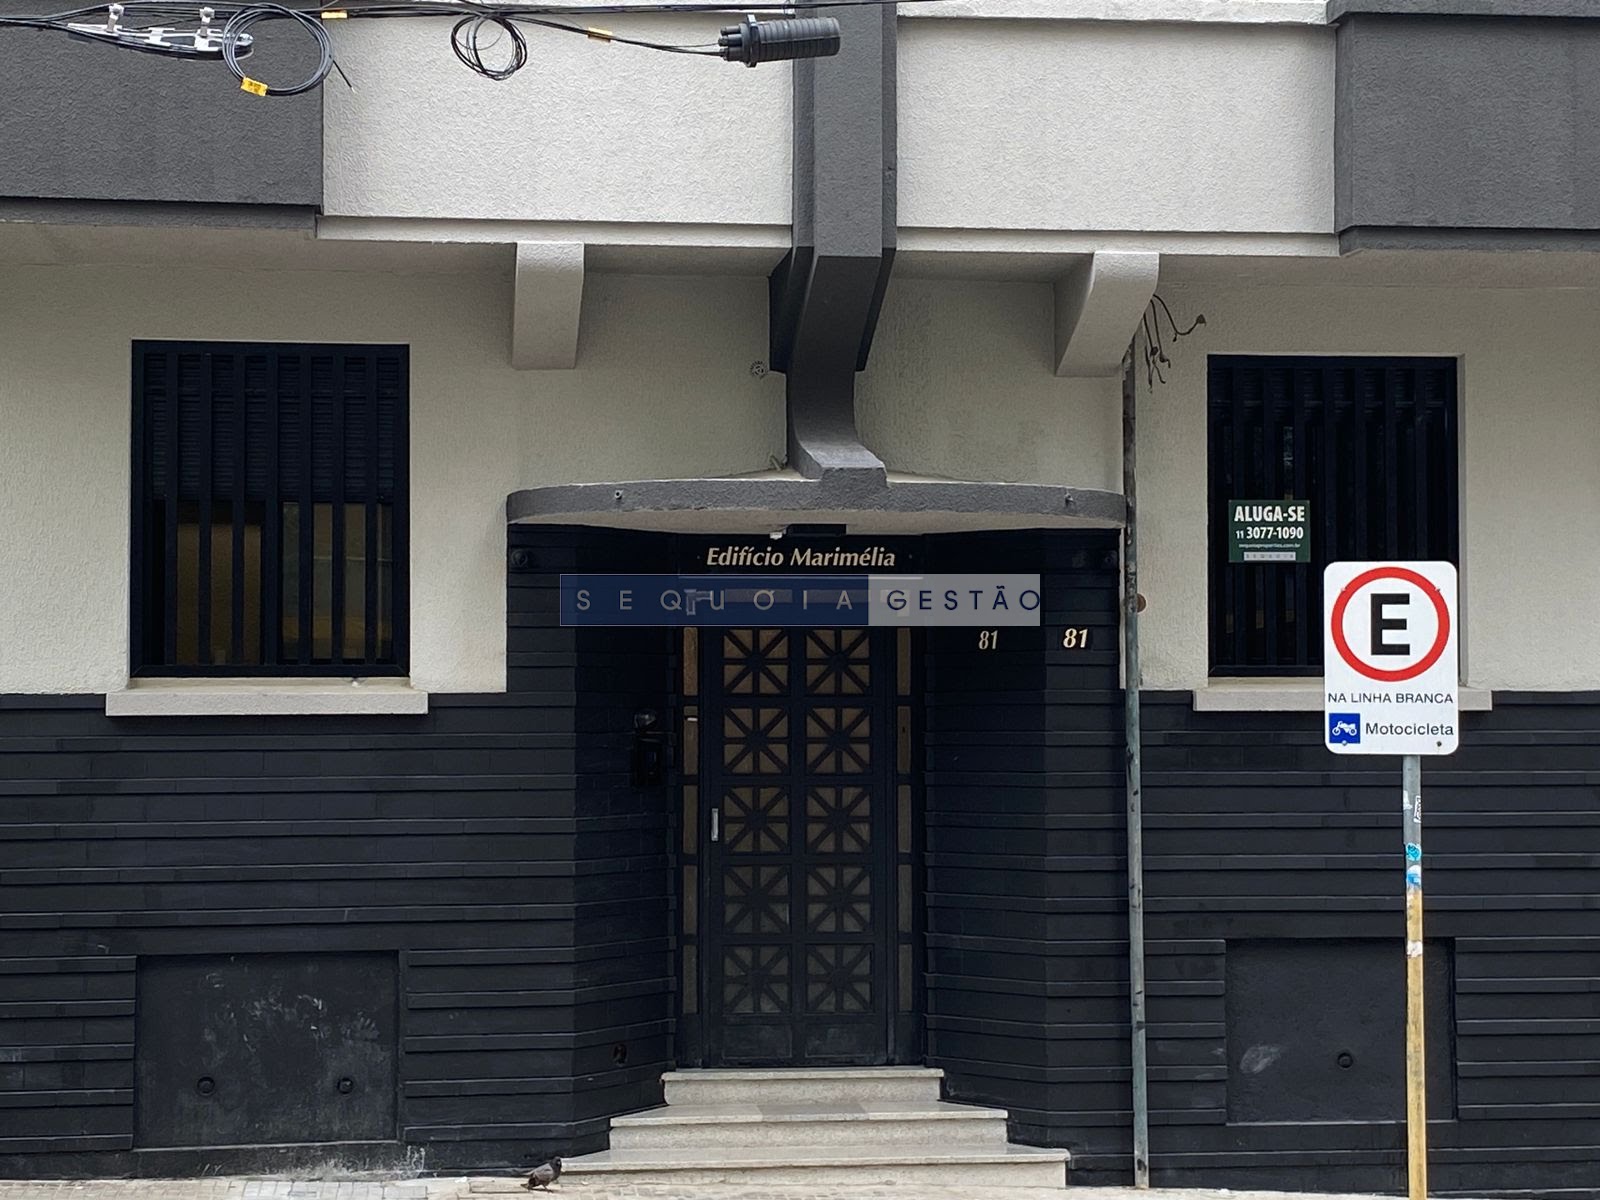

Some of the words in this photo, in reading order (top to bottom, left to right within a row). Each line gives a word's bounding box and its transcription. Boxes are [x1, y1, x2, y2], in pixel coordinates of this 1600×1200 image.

[1234, 505, 1305, 522] ALUGA-SE
[1235, 530, 1244, 539] 11
[1246, 526, 1304, 539] 3077-1090
[706, 546, 784, 566] Edifício
[790, 547, 896, 566] Marimélia
[1370, 593, 1411, 656] E
[978, 630, 998, 650] 81
[1063, 628, 1088, 648] 81
[1328, 693, 1347, 703] NA
[1351, 693, 1392, 703] LINHA
[1395, 693, 1454, 704] BRANCA
[1365, 722, 1454, 736] Motocicleta
